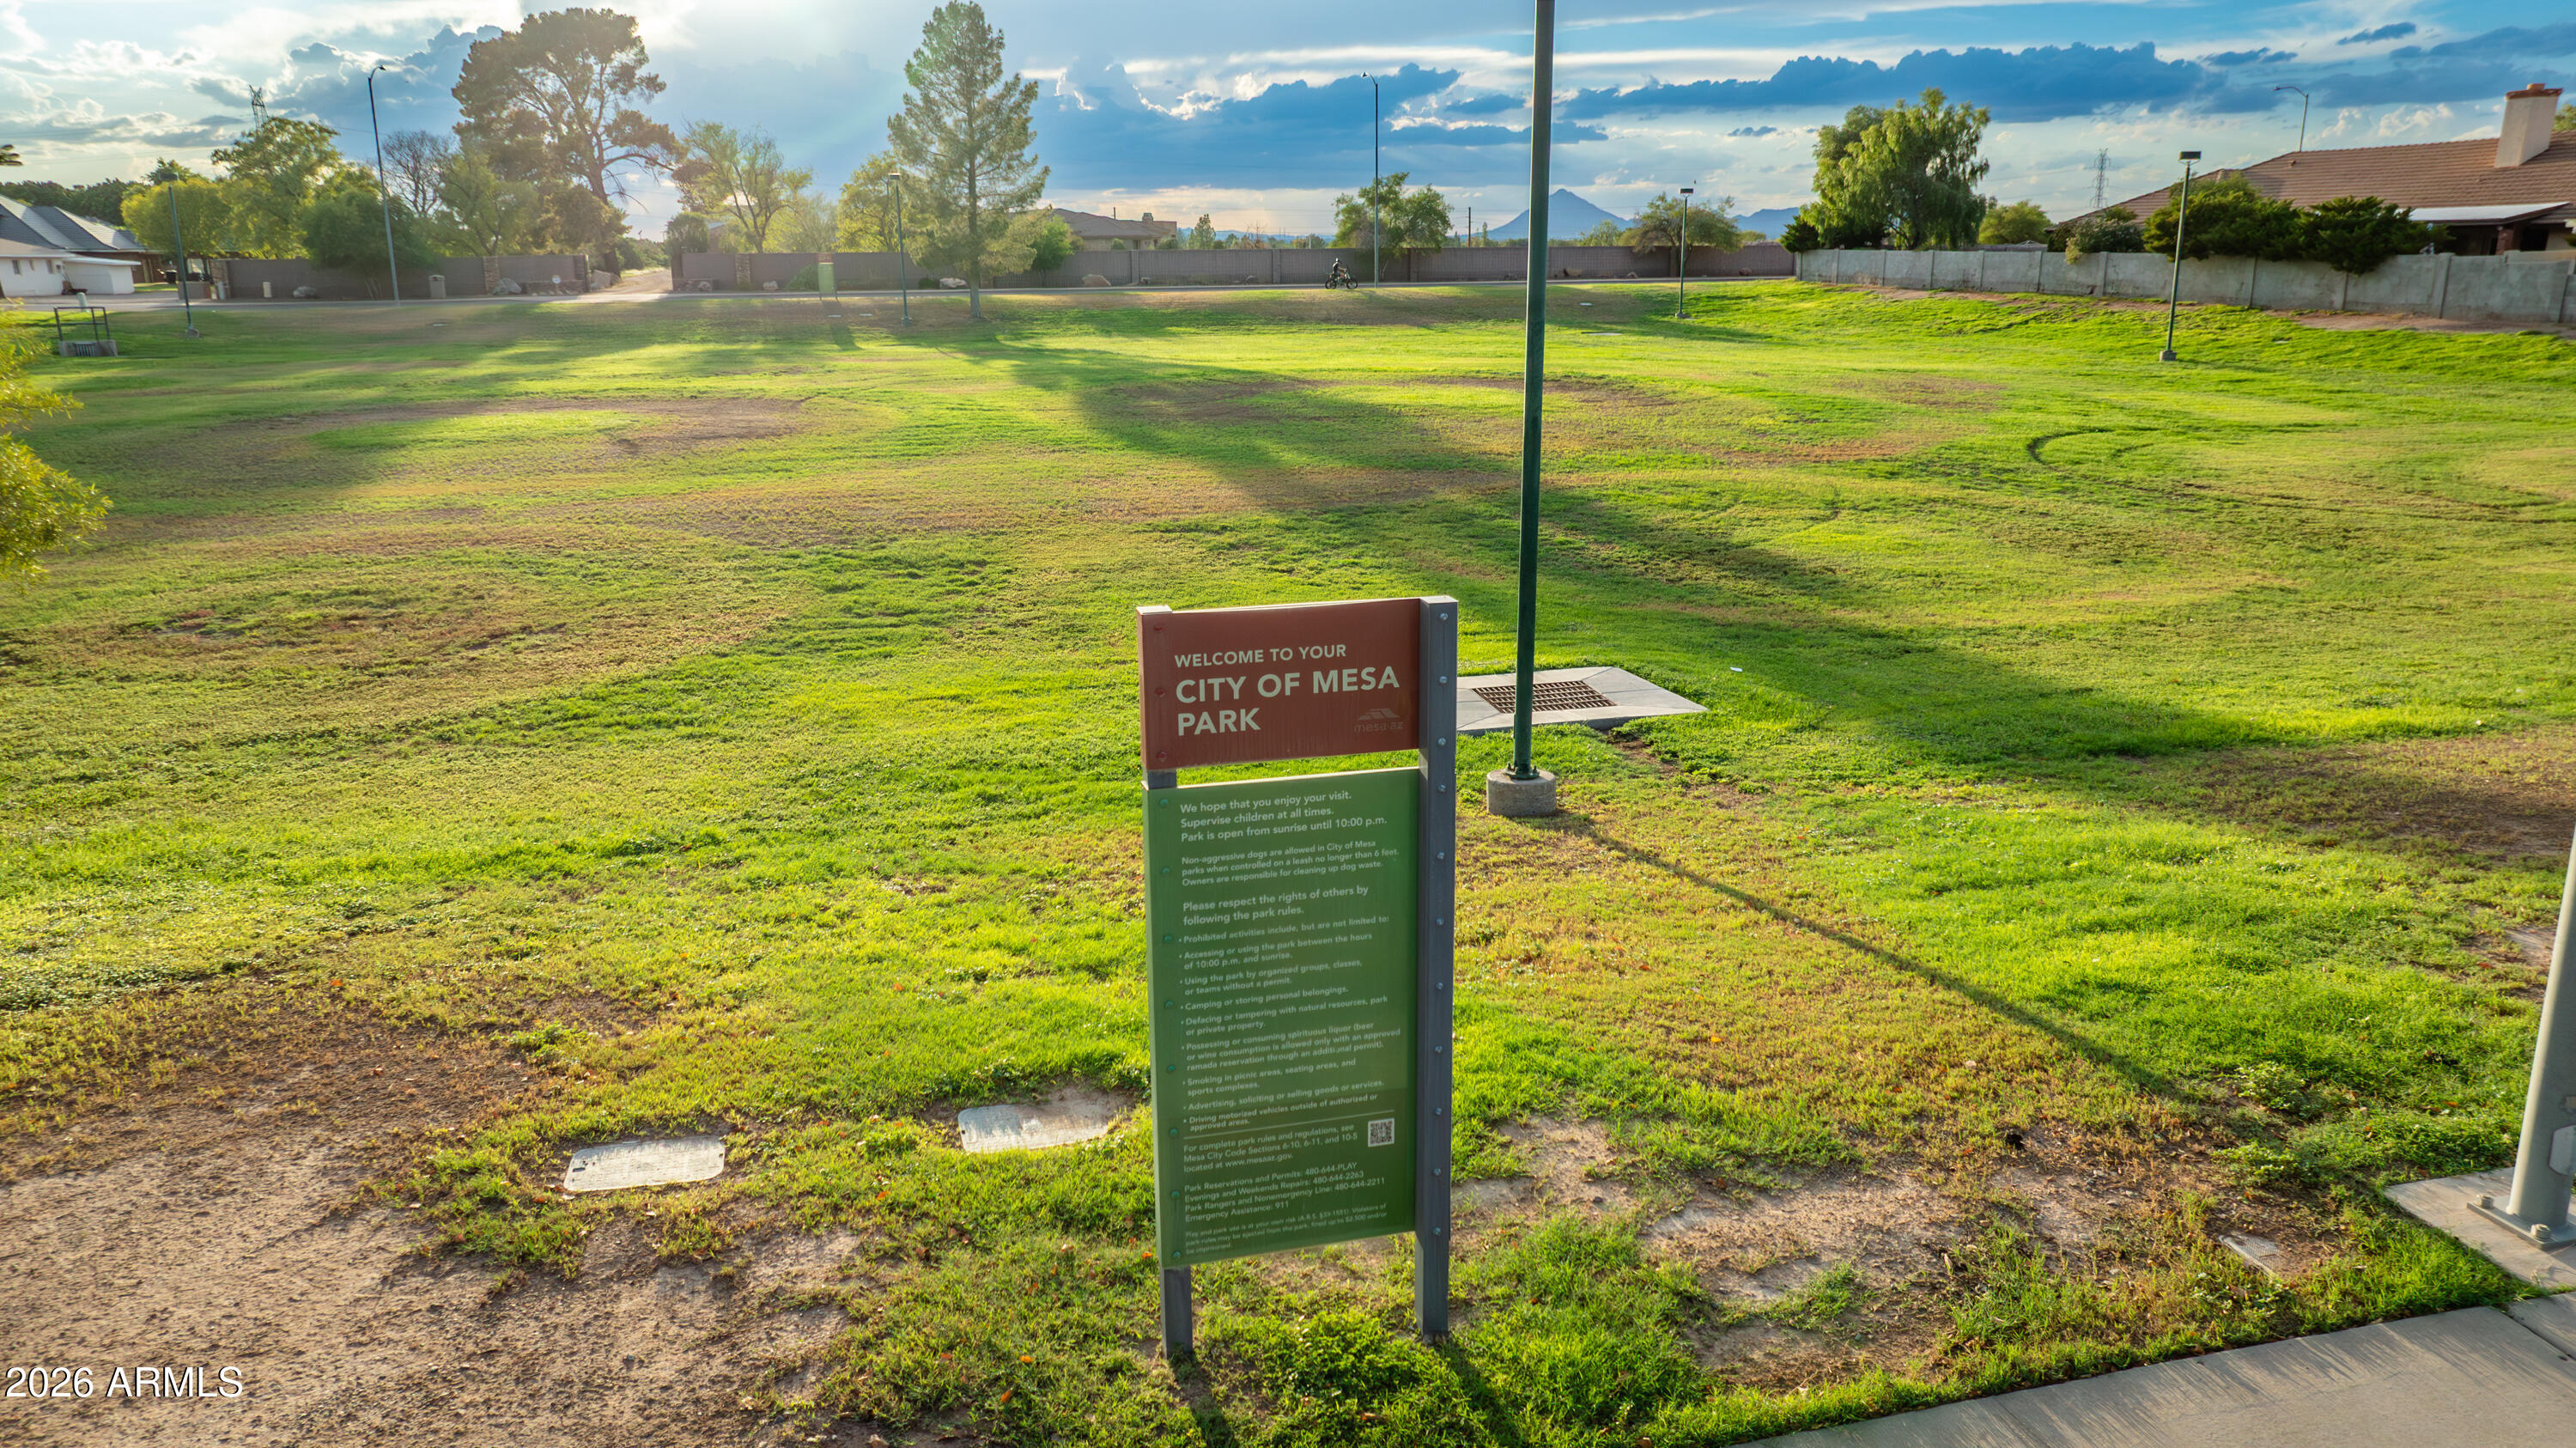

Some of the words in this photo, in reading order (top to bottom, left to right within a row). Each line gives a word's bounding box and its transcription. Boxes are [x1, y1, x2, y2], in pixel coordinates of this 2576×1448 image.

[1175, 649, 1265, 667] WELCOME
[1270, 648, 1293, 661] TO
[1299, 644, 1346, 660] YOUR
[1176, 676, 1247, 703] CITY
[1258, 672, 1301, 697] OF
[1314, 666, 1400, 694] MESA
[1178, 708, 1261, 736] PARK
[1180, 804, 1197, 813] We
[1200, 803, 1226, 813] hope
[1230, 799, 1250, 809] that
[1253, 800, 1271, 810] you
[1274, 797, 1301, 806] enjoy
[1303, 795, 1326, 805] your
[1328, 790, 1352, 800] visit.
[1181, 816, 1230, 829] Supervise
[1234, 812, 1274, 823] children
[1277, 810, 1287, 818] at
[1290, 808, 1301, 818] all
[1303, 807, 1334, 817] times.
[1182, 831, 1204, 842] Park
[1207, 830, 1214, 840] is
[1218, 830, 1243, 841] open
[1246, 827, 1270, 836] from
[1273, 823, 1307, 834] sunrise
[1310, 819, 1332, 830] until
[1335, 817, 1363, 828] 10:00
[1365, 818, 1387, 828] p.m.
[1182, 853, 1245, 864] Non-aggressive
[1285, 845, 1315, 855] allowed
[1327, 843, 1343, 851] City
[1182, 867, 1204, 877] parks
[1230, 860, 1271, 870] controlled
[1382, 848, 1400, 856] feet.
[1231, 870, 1278, 882] responsible
[1293, 866, 1326, 875] cleaning
[1340, 863, 1356, 872] dog
[1358, 861, 1382, 869] waste.
[1183, 902, 1215, 911] Please
[1218, 896, 1255, 909] respect
[1259, 894, 1275, 903] the
[1279, 891, 1307, 903] rights
[1309, 889, 1320, 898] of
[1322, 887, 1354, 897] others
[1357, 885, 1369, 896] by
[1183, 913, 1230, 925] following
[1233, 910, 1249, 920] the
[1252, 908, 1274, 921] park
[1278, 906, 1304, 916] rules.
[1183, 932, 1226, 943] Prohibited
[1229, 928, 1265, 938] activities
[1333, 919, 1346, 928] not
[1348, 916, 1376, 926] limited
[1184, 949, 1224, 958] Accessing
[1277, 940, 1295, 951] park
[1196, 958, 1219, 968] 10:00
[1243, 954, 1259, 963] and
[1226, 971, 1243, 982] park
[1246, 970, 1256, 979] by
[1259, 965, 1298, 977] organized
[1223, 981, 1254, 990] without
[1185, 1001, 1222, 1010] Camping
[1235, 995, 1264, 1004] storing
[1266, 990, 1300, 1002] personal
[1302, 987, 1348, 996] belongings.
[1185, 1015, 1222, 1025] Defacing
[1235, 1009, 1277, 1019] tampering
[1279, 1006, 1297, 1014] with
[1298, 1002, 1326, 1012] natural
[1328, 1000, 1368, 1008] resources,
[1370, 995, 1388, 1006] park
[1197, 1025, 1225, 1036] private
[1185, 1212, 1228, 1221] Emergency
